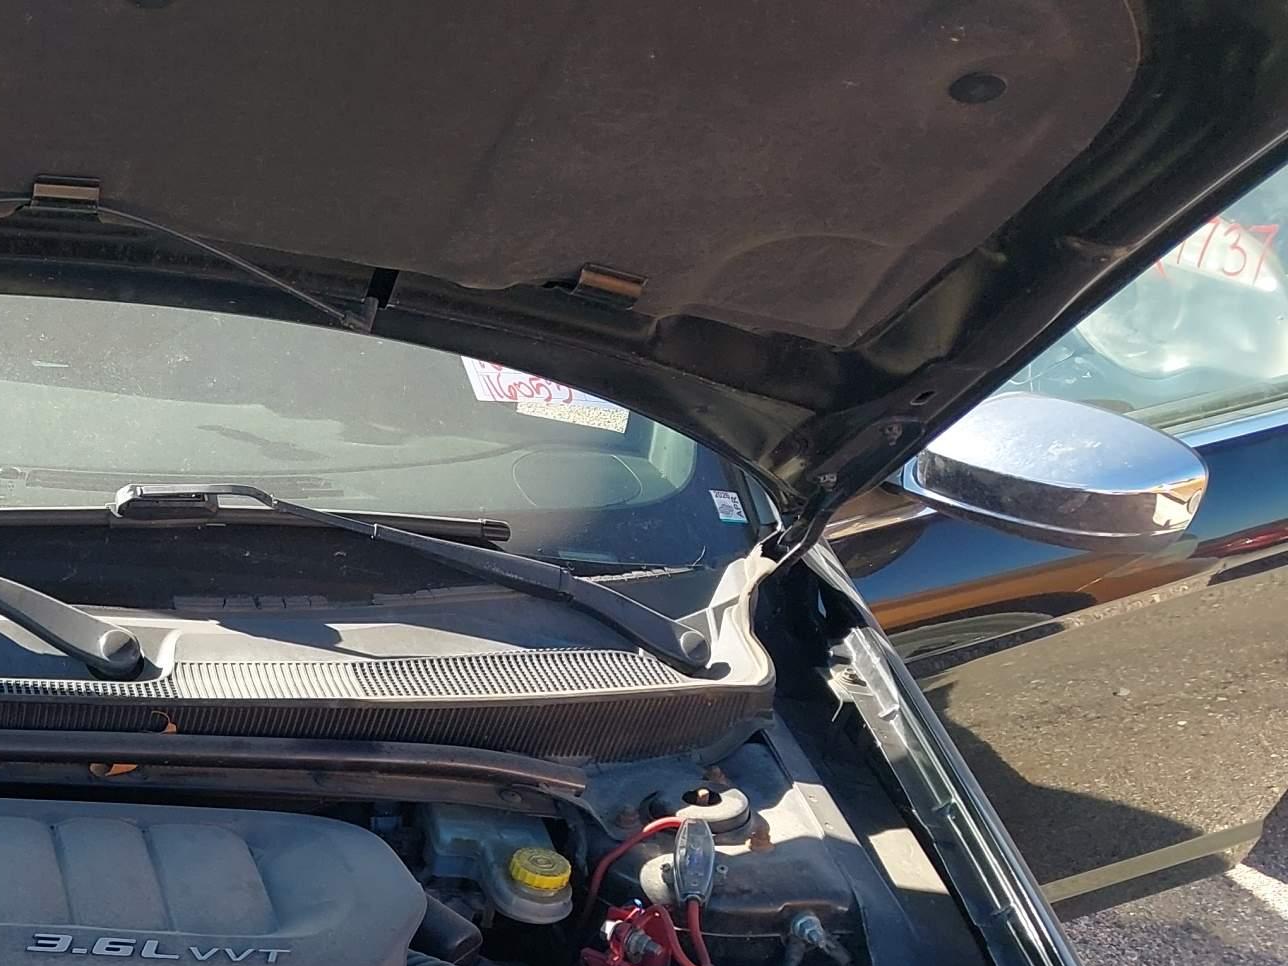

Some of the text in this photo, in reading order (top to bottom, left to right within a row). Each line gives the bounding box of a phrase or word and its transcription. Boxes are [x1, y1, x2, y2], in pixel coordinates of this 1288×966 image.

[730, 496, 745, 518] APR
[26, 933, 292, 964] 3.6L VVT
